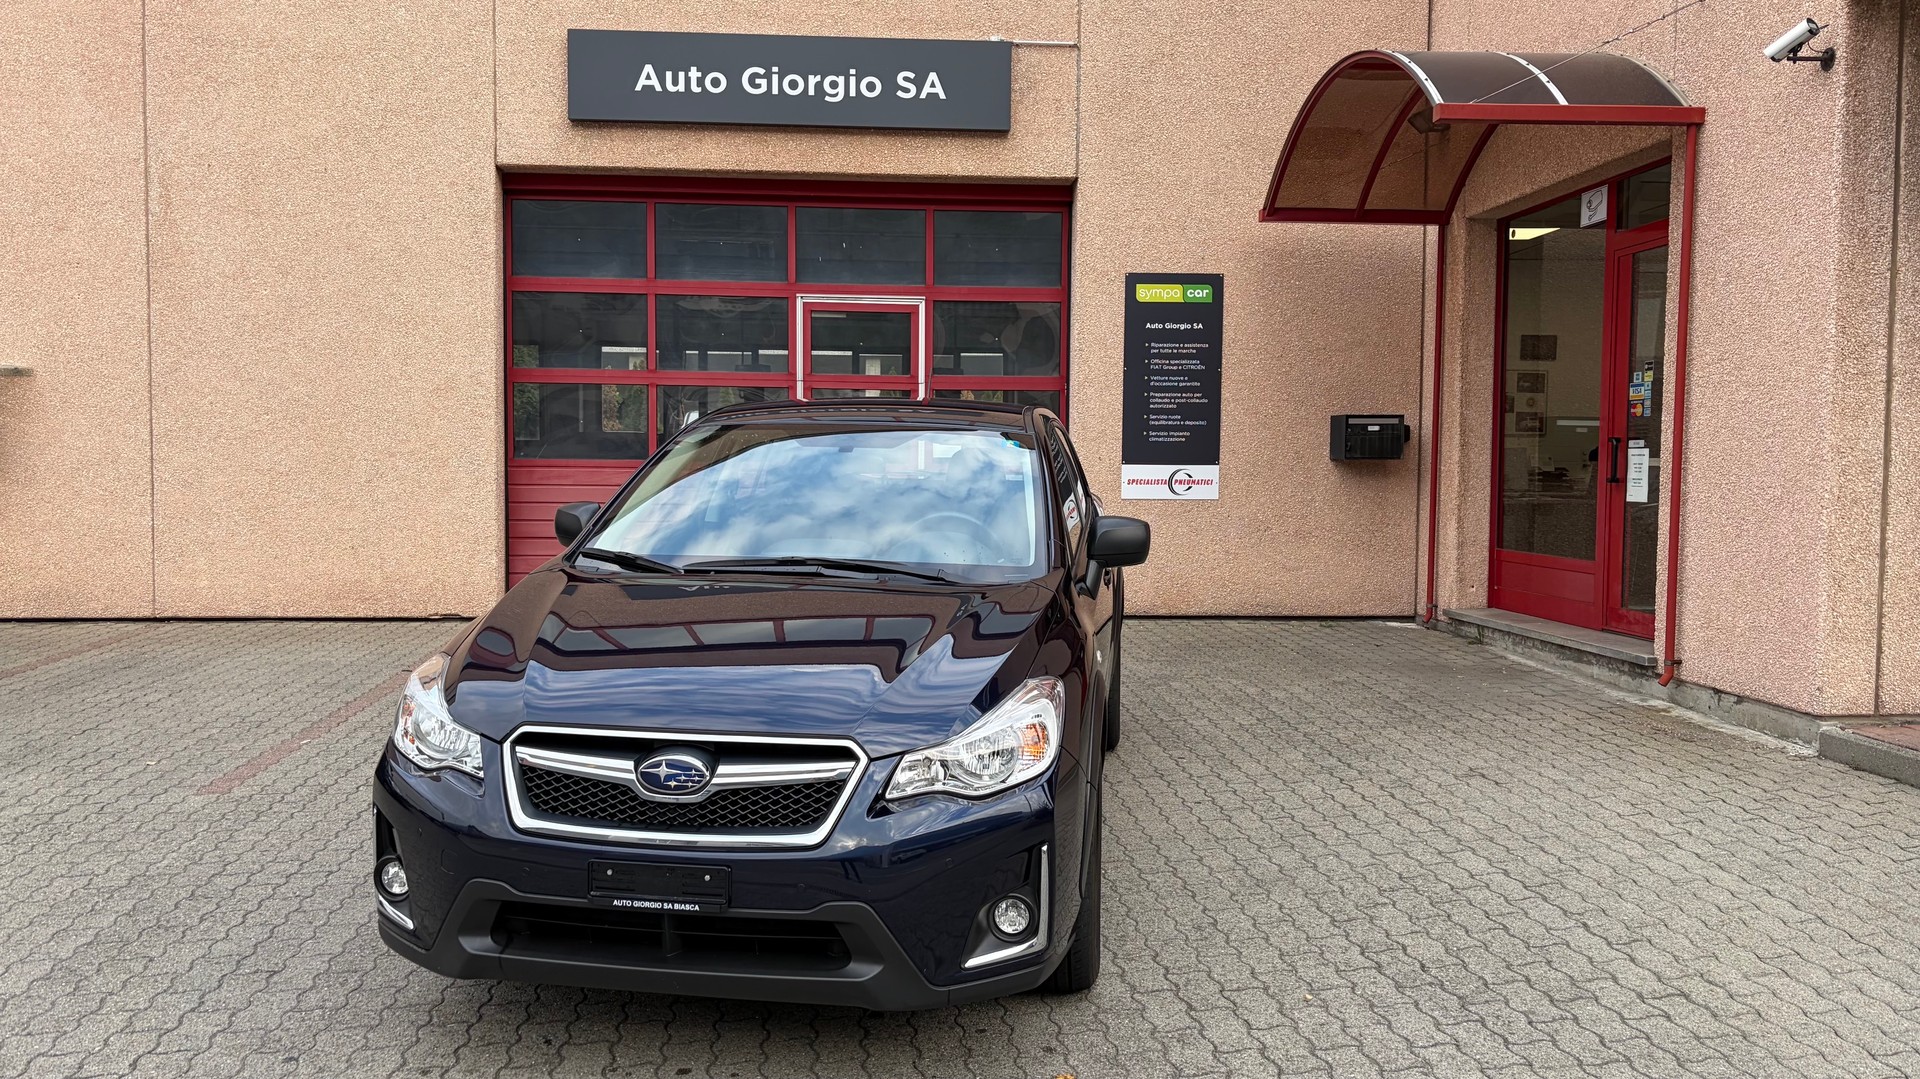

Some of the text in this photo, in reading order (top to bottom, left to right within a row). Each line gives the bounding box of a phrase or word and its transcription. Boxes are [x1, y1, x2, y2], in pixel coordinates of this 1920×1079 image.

[634, 63, 947, 103] Auto Giorgio SA
[1139, 288, 1209, 299] sympa car
[1164, 322, 1191, 330] Giorgio
[612, 899, 632, 907] AUTO
[633, 900, 662, 909] GIORGIO
[674, 903, 700, 911] BIASCA
